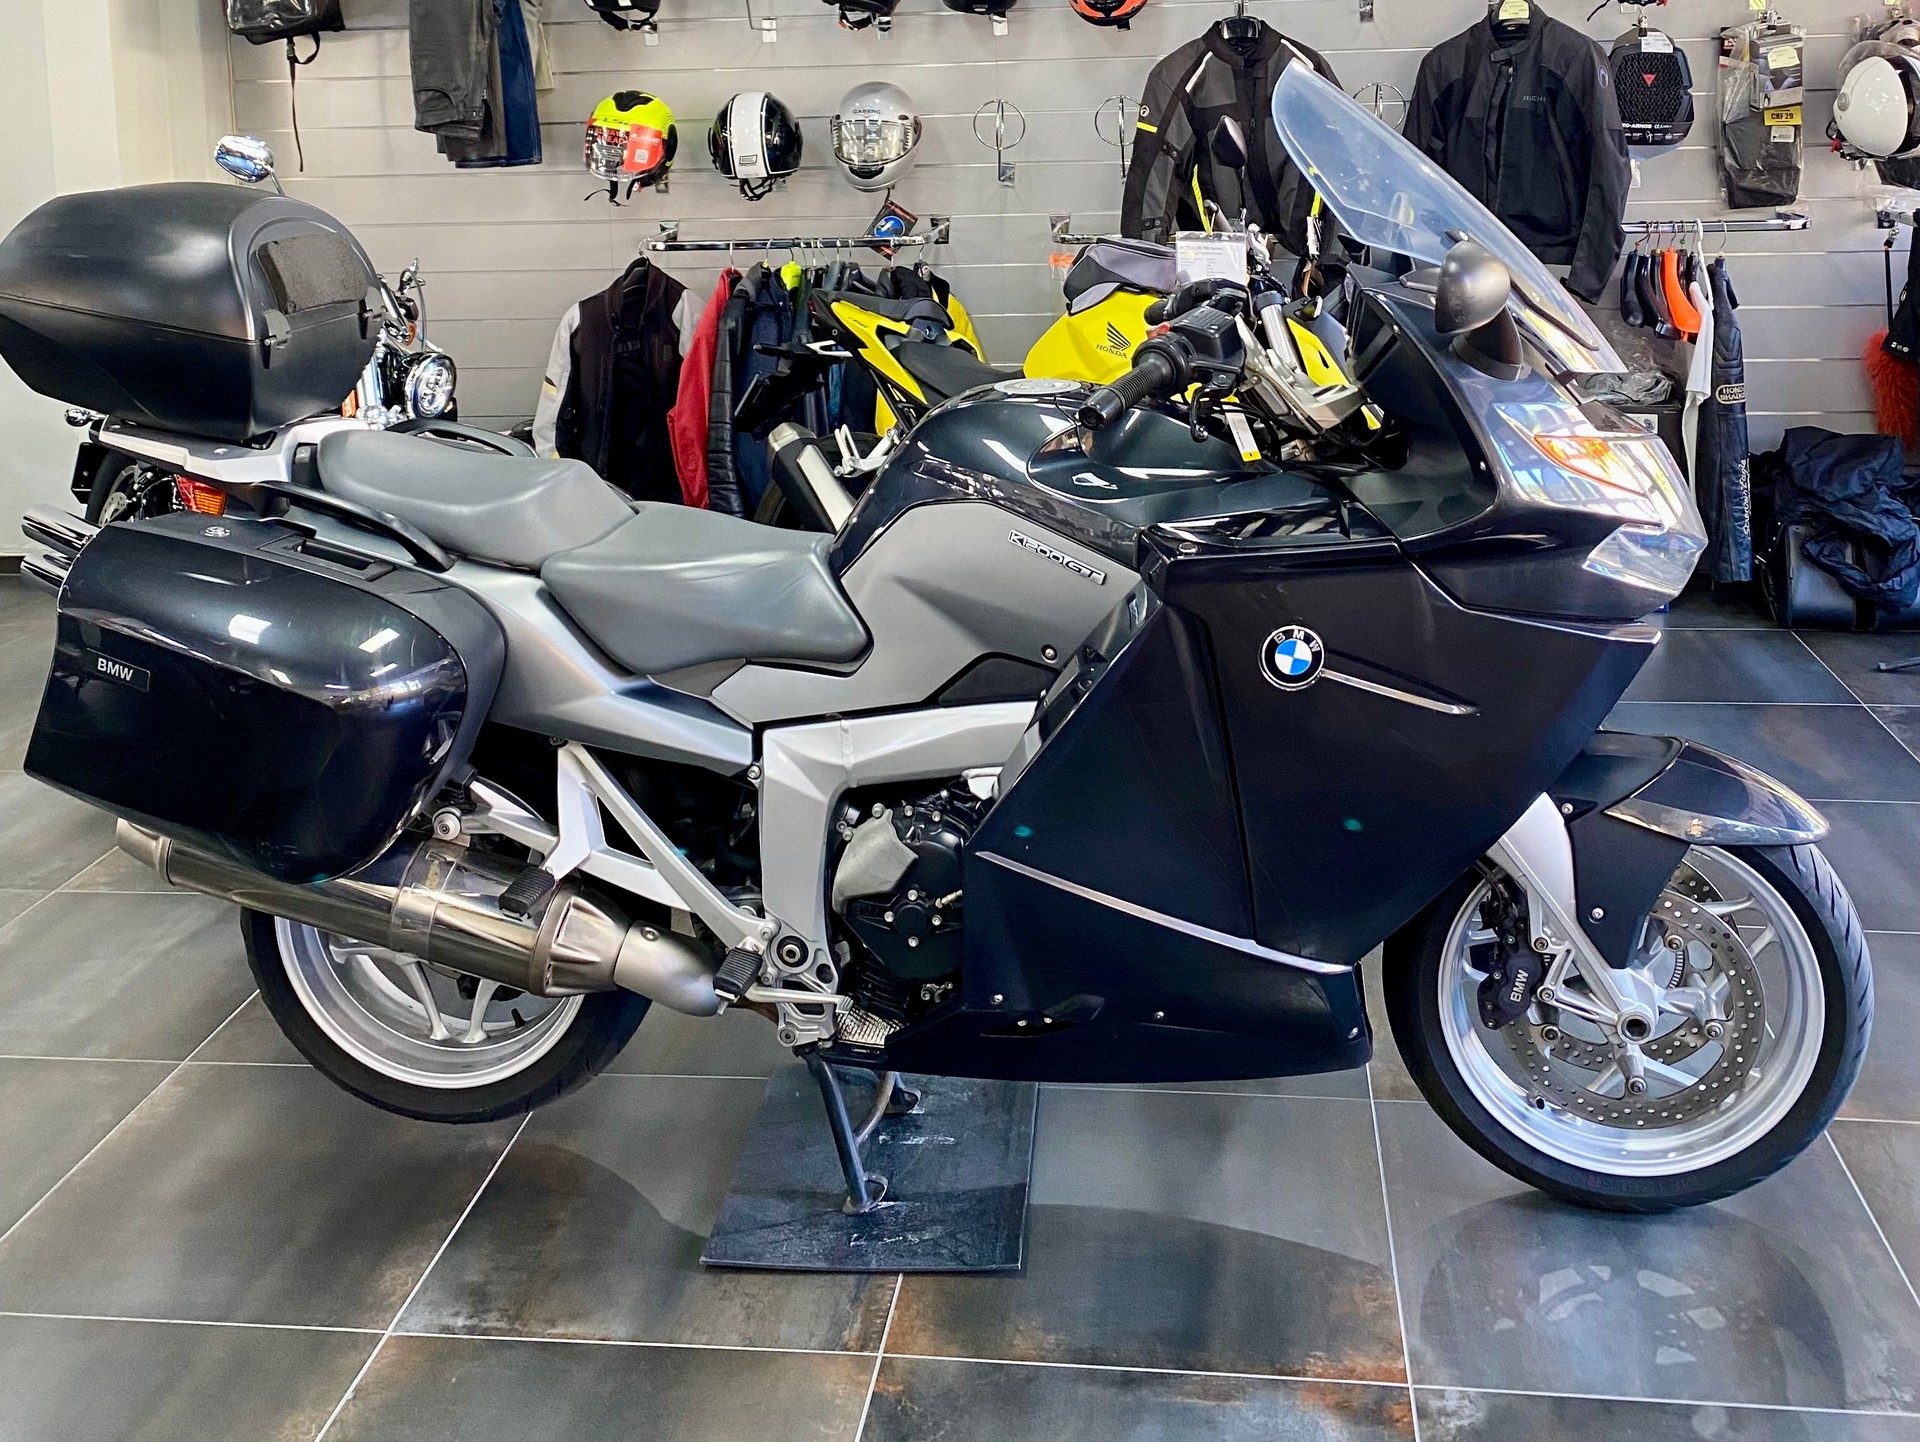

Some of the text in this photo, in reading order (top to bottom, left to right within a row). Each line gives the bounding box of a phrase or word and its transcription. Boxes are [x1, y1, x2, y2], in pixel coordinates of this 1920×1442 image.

[1096, 343, 1128, 359] HONDA
[1719, 392, 1745, 401] SHADO
[1722, 386, 1745, 394] HOND
[1273, 628, 1321, 653] BMW
[97, 657, 134, 681] BMW
[1510, 969, 1529, 1003] BMW
